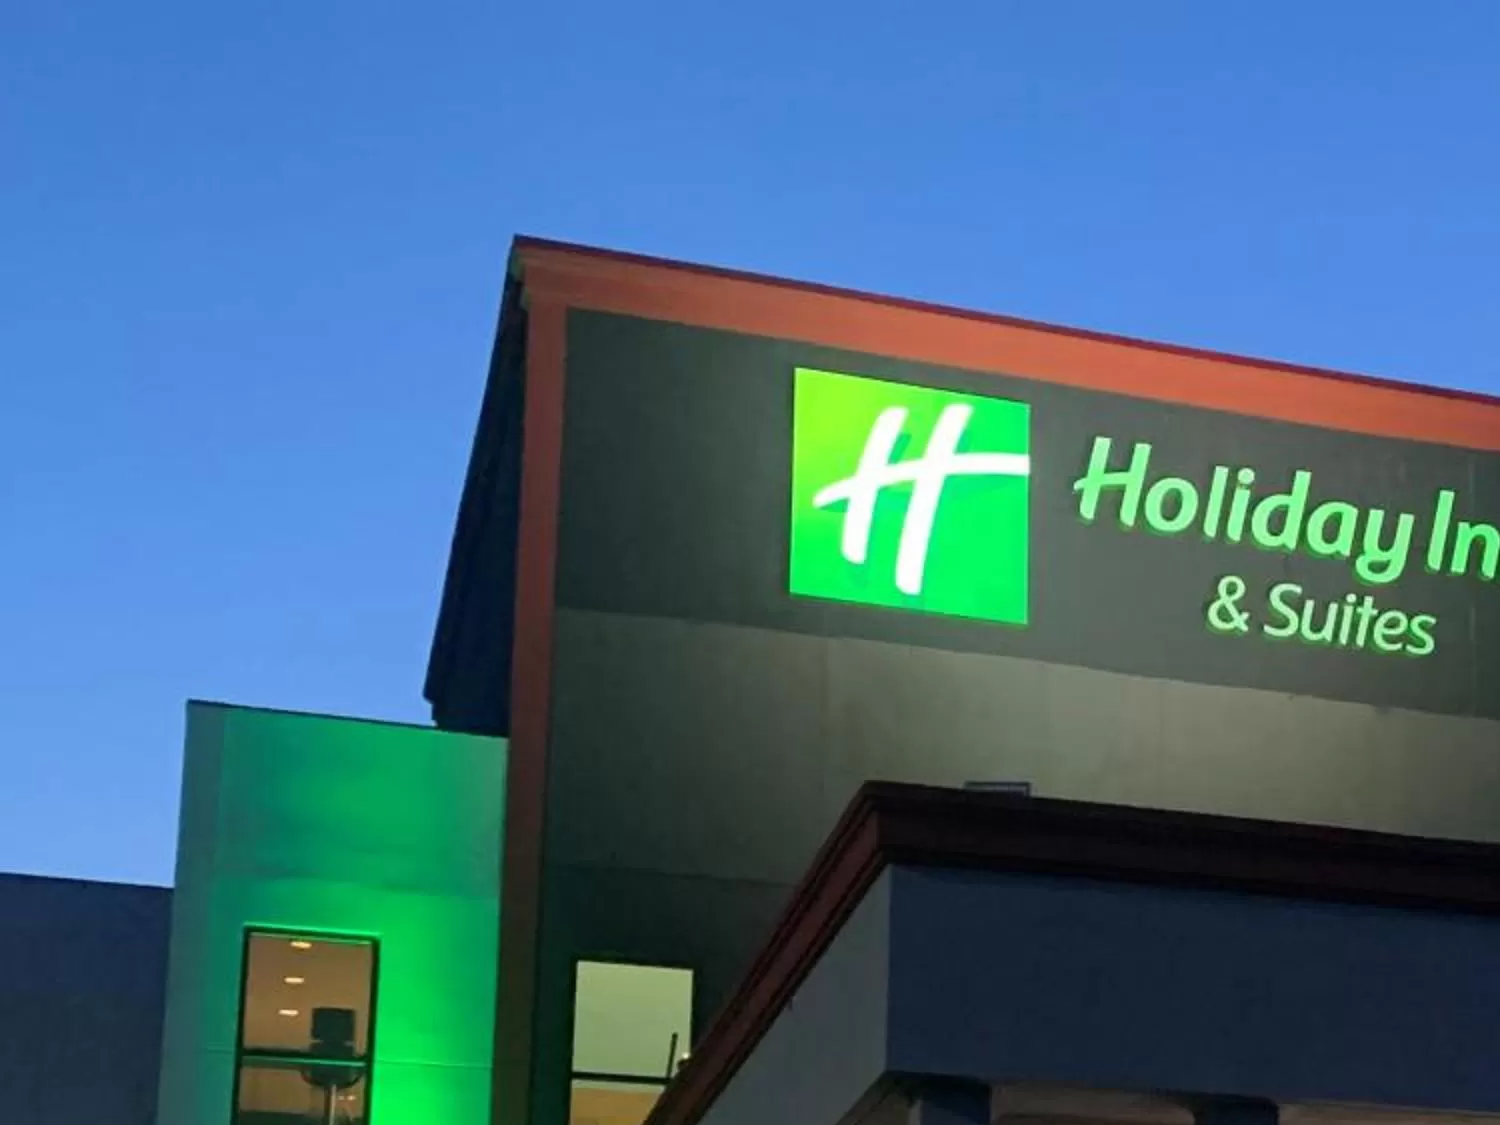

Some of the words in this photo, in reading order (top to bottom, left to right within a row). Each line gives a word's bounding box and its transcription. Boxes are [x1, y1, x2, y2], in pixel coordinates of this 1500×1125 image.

[813, 404, 1029, 594] H
[1073, 436, 1413, 584] Holiday
[1206, 576, 1249, 635] &
[1263, 583, 1437, 656] Suites
